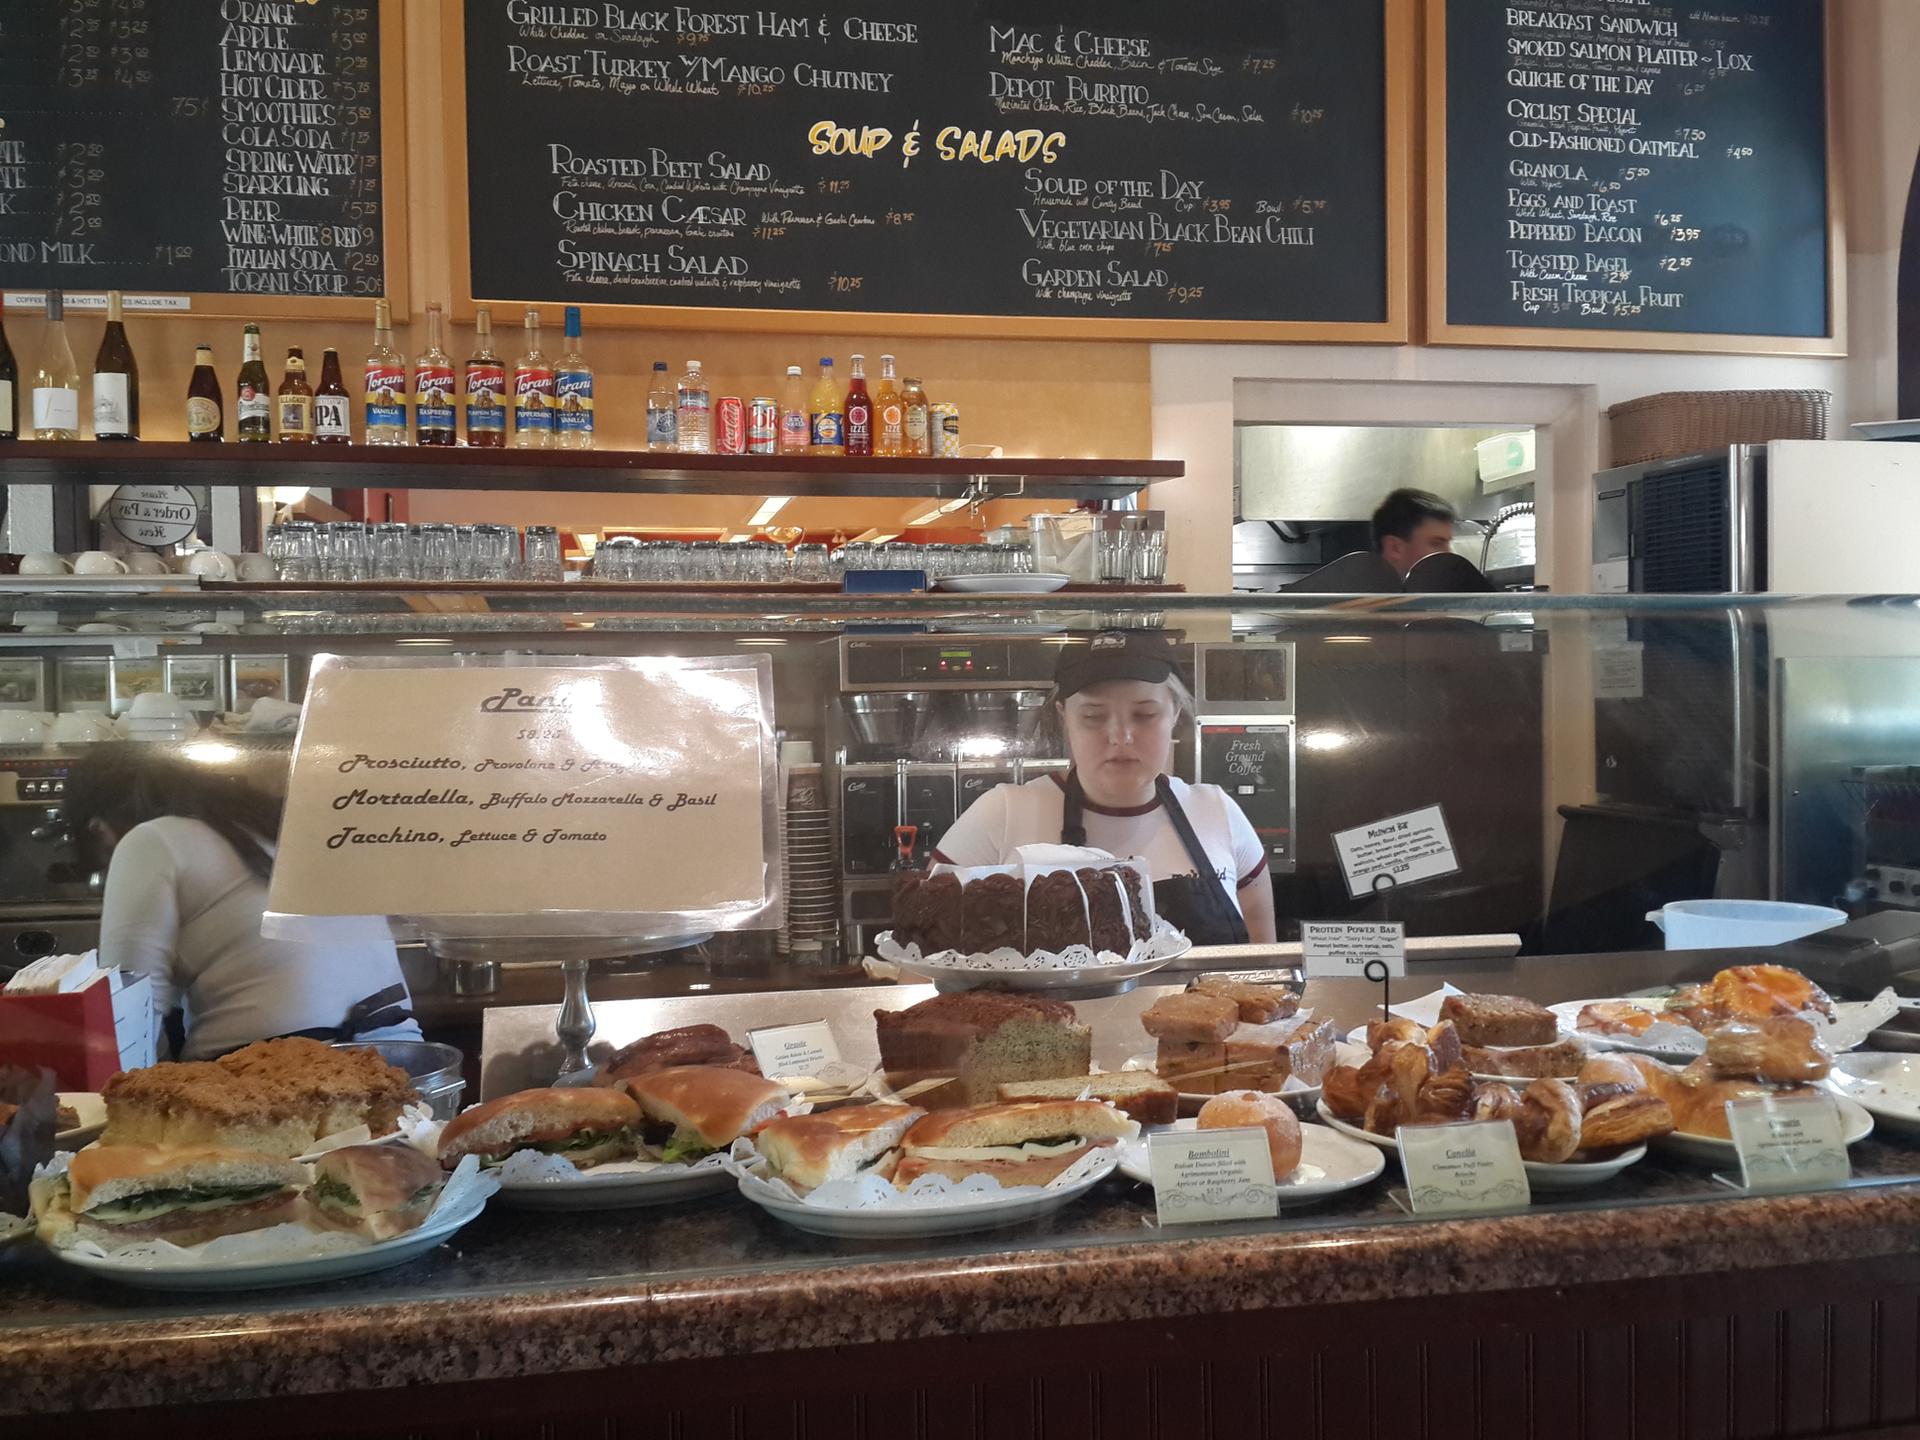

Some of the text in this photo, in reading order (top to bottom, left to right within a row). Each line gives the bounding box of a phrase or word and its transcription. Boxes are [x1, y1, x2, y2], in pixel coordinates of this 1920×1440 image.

[219, 22, 290, 50] APPLE
[603, 3, 671, 32] BLACK
[674, 7, 750, 35] FOREST
[756, 12, 810, 38] HAM
[843, 17, 920, 43] CHEESE
[1506, 7, 1594, 32] BREAKFAST
[1599, 15, 1678, 37] SANDWICH
[989, 25, 1043, 53] MAC
[1074, 31, 1151, 57] CHEESE
[1508, 37, 1566, 57] SMOKED
[1569, 41, 1632, 61] SALMON
[1636, 45, 1698, 67] PLATTER
[221, 46, 327, 75] LEMONADE
[507, 45, 895, 93] ROAST TURKEY CHUTNEY
[220, 73, 328, 100] HOT CIDER
[988, 71, 1149, 104] DEPOT BURRITO
[1507, 68, 1566, 88] QUICHE
[1591, 75, 1621, 93] THE
[1624, 75, 1655, 95] DAY
[221, 97, 337, 126] SMOOTHIES
[1507, 98, 1642, 126] CYCLIST SPECIAL
[221, 122, 335, 150] COLA SODA
[808, 120, 893, 158] SOUP
[935, 126, 1066, 163] SALADS
[1629, 138, 1700, 159] OATMEAL
[225, 147, 356, 175] SPRING WATER
[547, 143, 771, 181] ROASTED BEET SALAD
[1509, 160, 1588, 181] GRANOLA
[222, 171, 330, 197] SPARKLING
[1024, 167, 1087, 195] SOUP
[1120, 180, 1154, 198] THE
[1160, 169, 1204, 200] DAY
[222, 196, 283, 222] BEER
[552, 191, 653, 222] CHICKEN
[1507, 188, 1638, 214] EGGS AND TOAST
[1016, 208, 1314, 246] VEGETARIAN BLACK BEAN CHILI
[1507, 219, 1642, 243] PEPPERED BACON
[226, 243, 338, 271] ITALIAN SODA
[556, 239, 749, 276] SPINACH SALAD
[1506, 250, 1632, 273] TOASTED BAGEL
[221, 267, 348, 293] TORANI SYRUP
[1022, 258, 1169, 288] GARDEN SALAD
[1509, 280, 1686, 307] FRESH TROPICAL FRUIT
[366, 368, 404, 392] Torani
[416, 370, 453, 394] Torani
[466, 371, 503, 394] Torani
[516, 373, 552, 395] Torani
[556, 376, 591, 396] Torani
[338, 754, 466, 773] Prosciutto,
[332, 789, 473, 810] Mortadella,
[480, 793, 548, 810] Buffalo
[551, 794, 645, 808] Mozzarella
[667, 794, 716, 812] Basil
